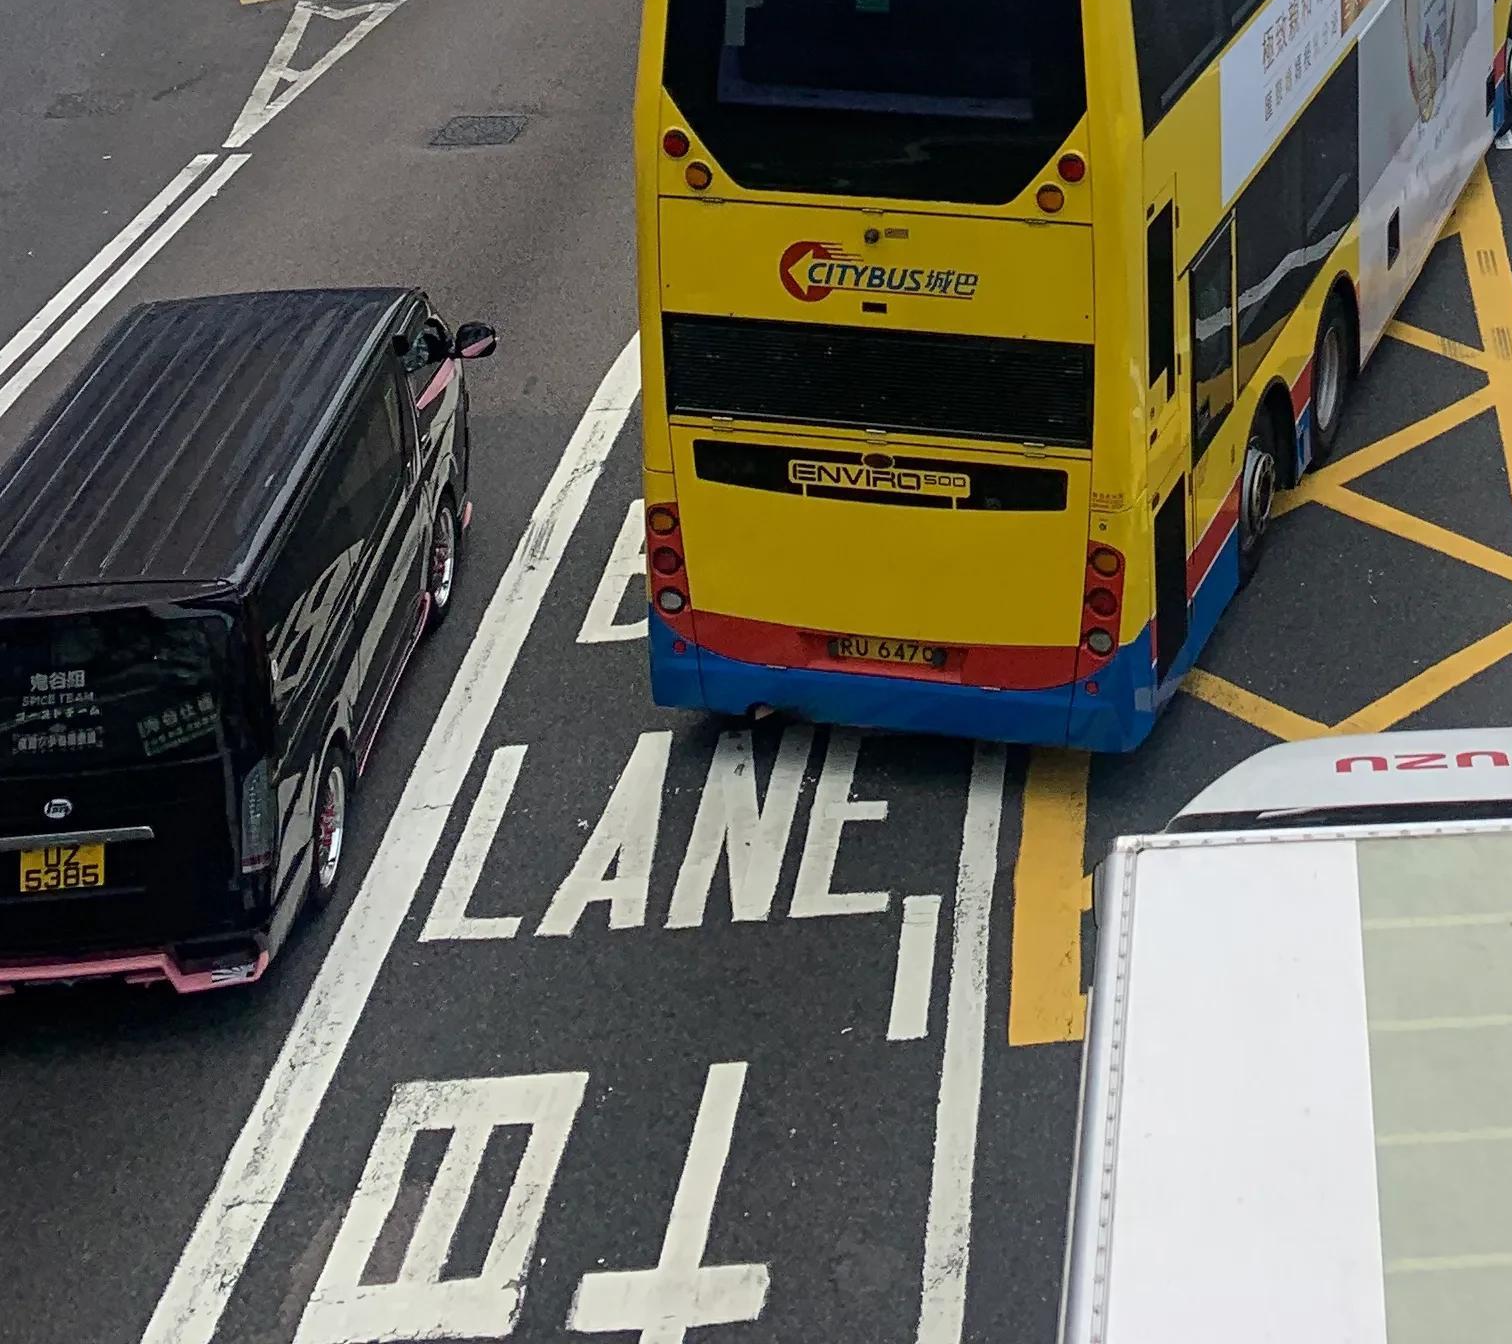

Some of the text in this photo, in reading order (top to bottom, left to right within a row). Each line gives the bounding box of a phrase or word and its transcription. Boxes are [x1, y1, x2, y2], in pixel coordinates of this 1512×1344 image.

[807, 261, 979, 296] CITYBUS 城巴
[840, 639, 869, 658] RU
[418, 730, 889, 942] LANE
[25, 863, 100, 892] 5385
